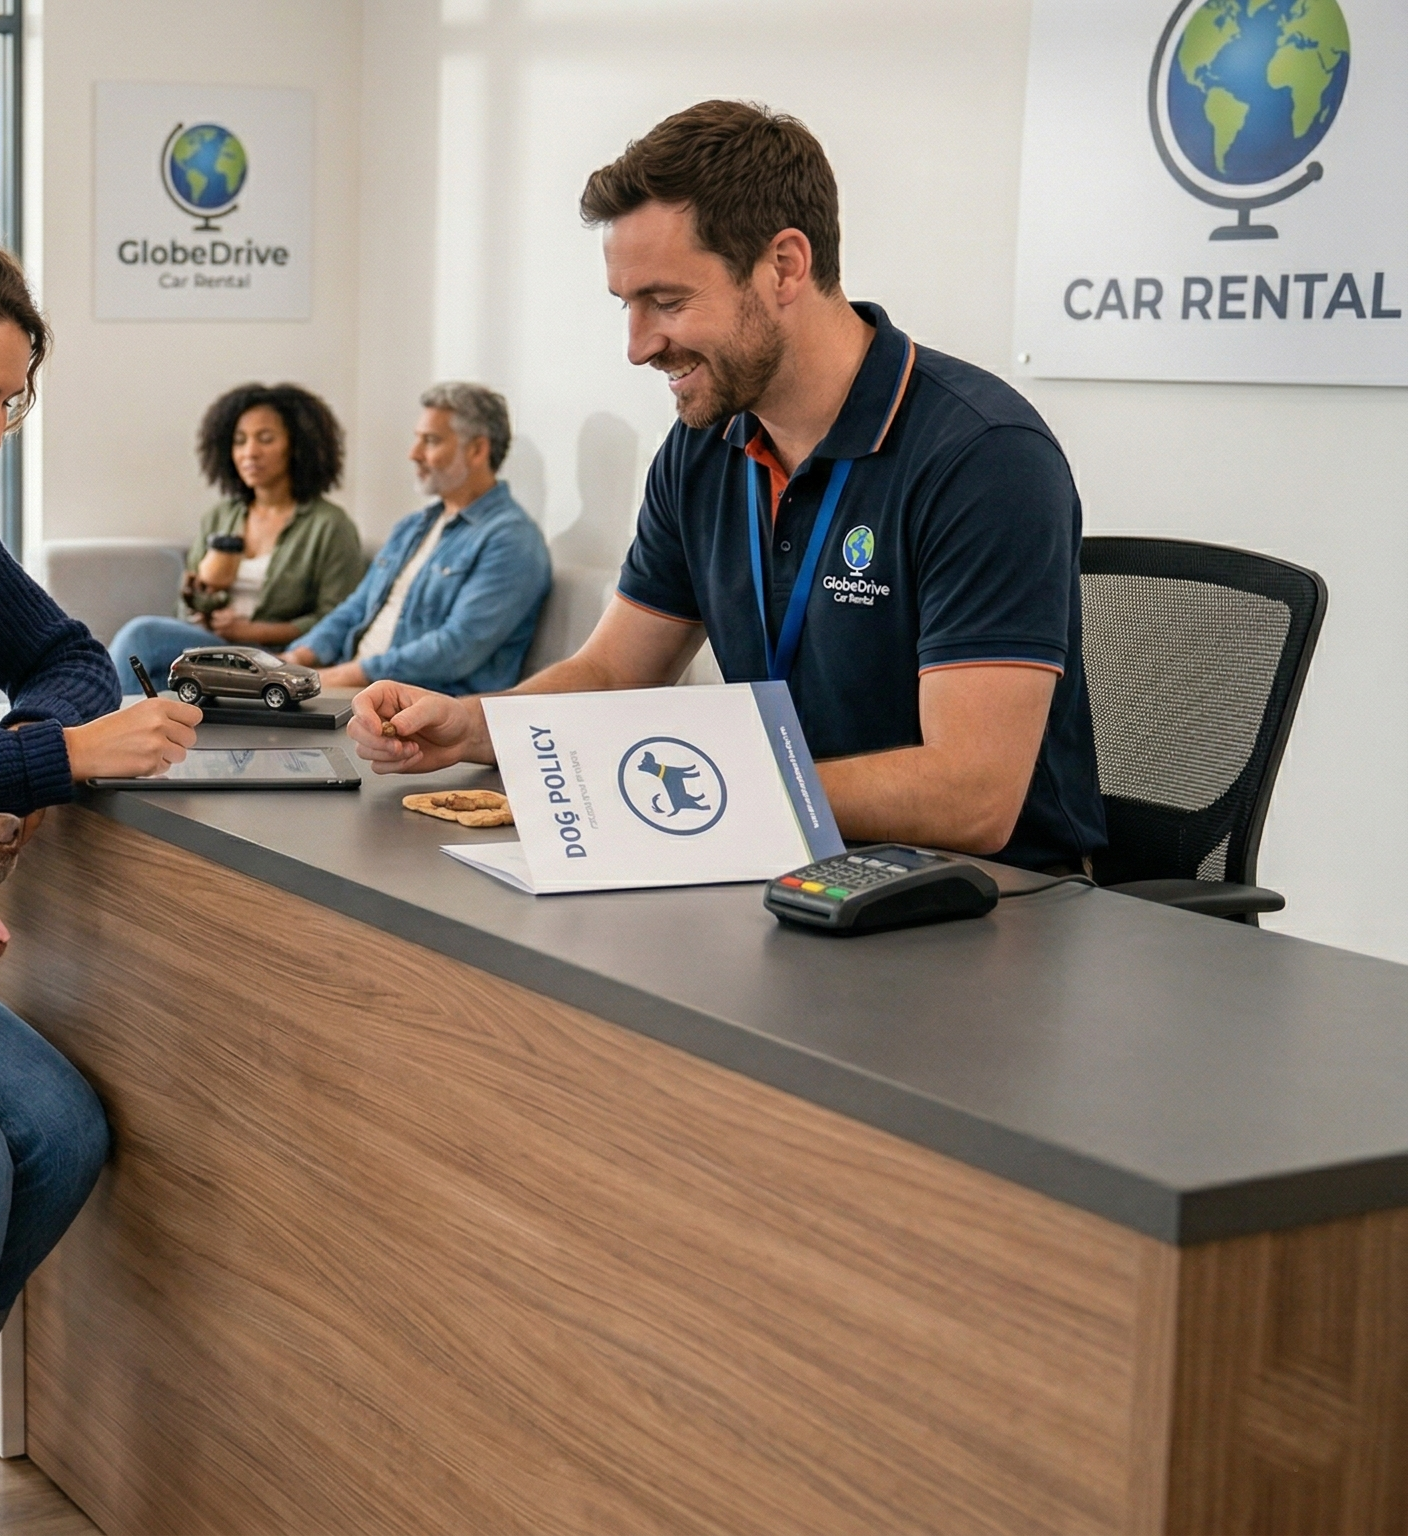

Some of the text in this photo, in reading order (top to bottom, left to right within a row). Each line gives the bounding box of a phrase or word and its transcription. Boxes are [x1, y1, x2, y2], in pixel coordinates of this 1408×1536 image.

[117, 239, 290, 266] GlobeDrive
[158, 272, 252, 289] Car Rental
[1063, 272, 1402, 321] CAR RENTAL
[823, 575, 890, 596] GlobeDrive
[528, 725, 572, 804] POLICY
[554, 811, 588, 859] DOG
